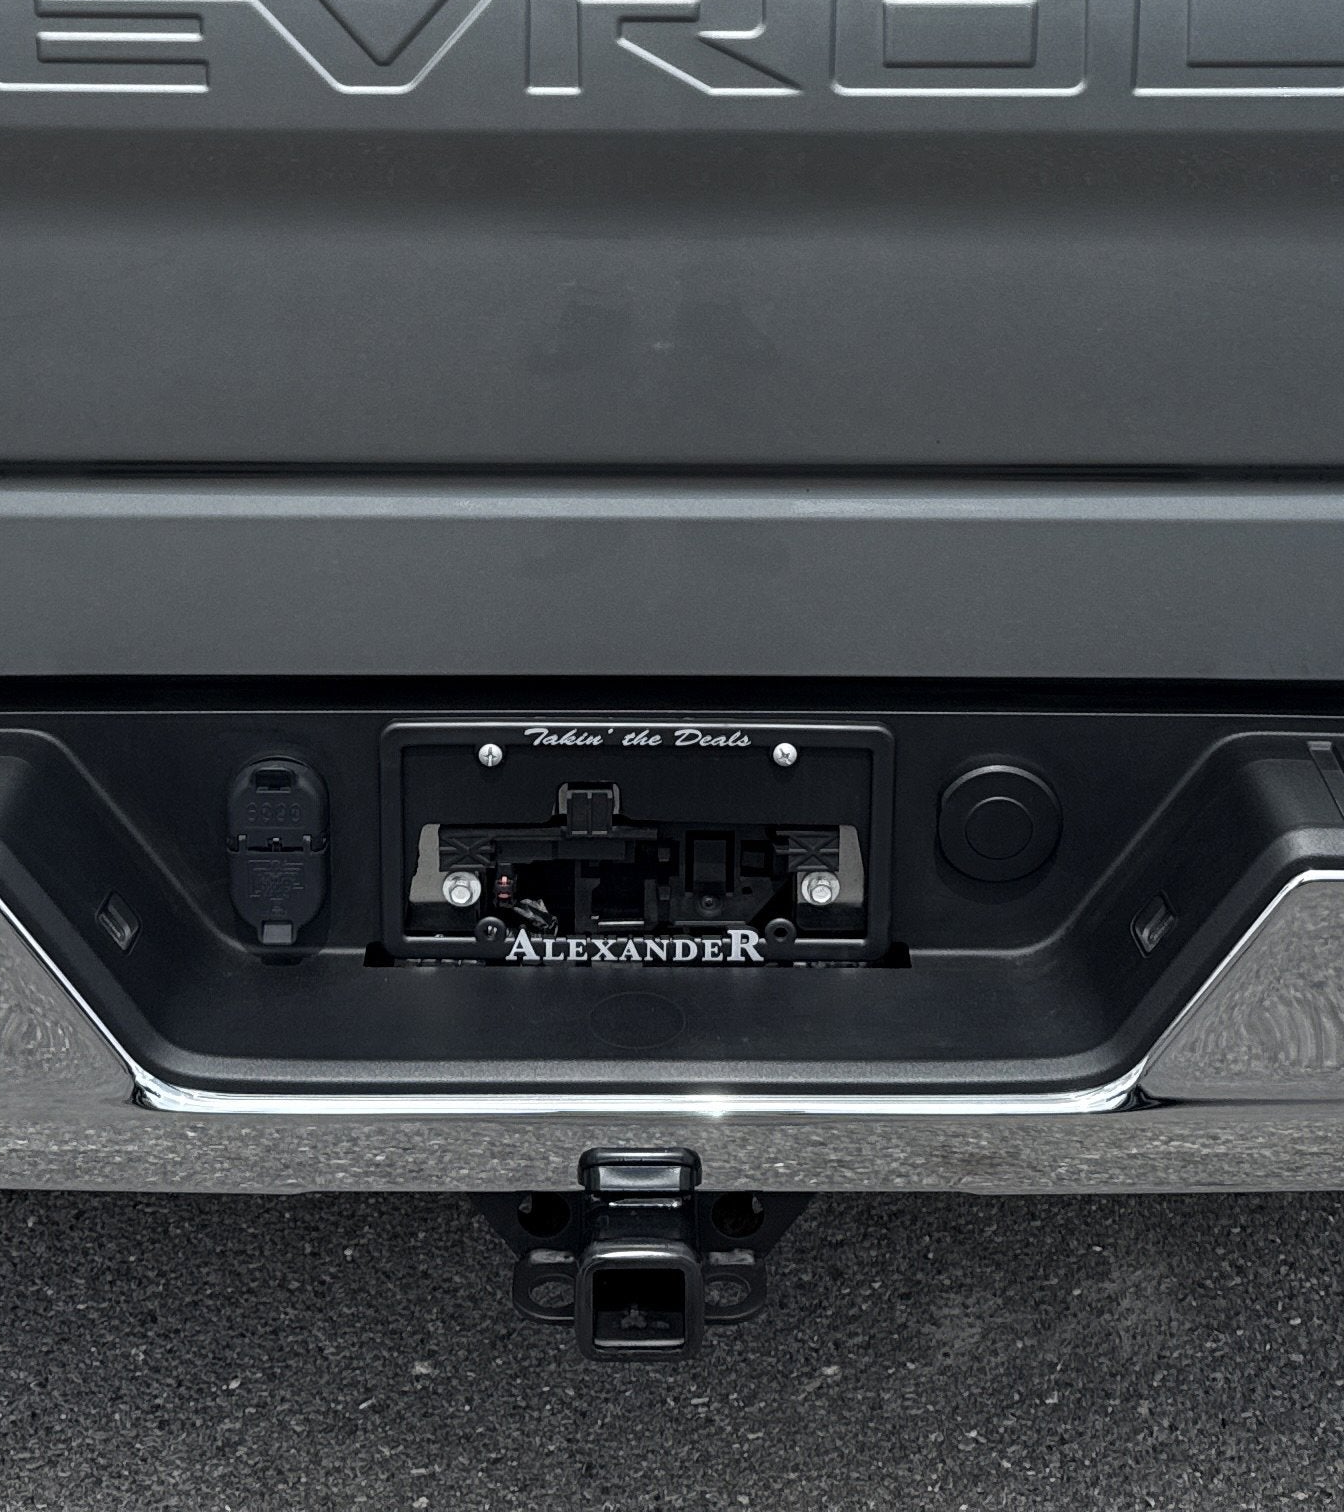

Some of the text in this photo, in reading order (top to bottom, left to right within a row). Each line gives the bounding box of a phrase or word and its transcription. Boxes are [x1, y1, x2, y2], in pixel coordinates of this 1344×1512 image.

[524, 728, 752, 747] Takin' the Deals
[505, 928, 765, 962] ALEXANDER
